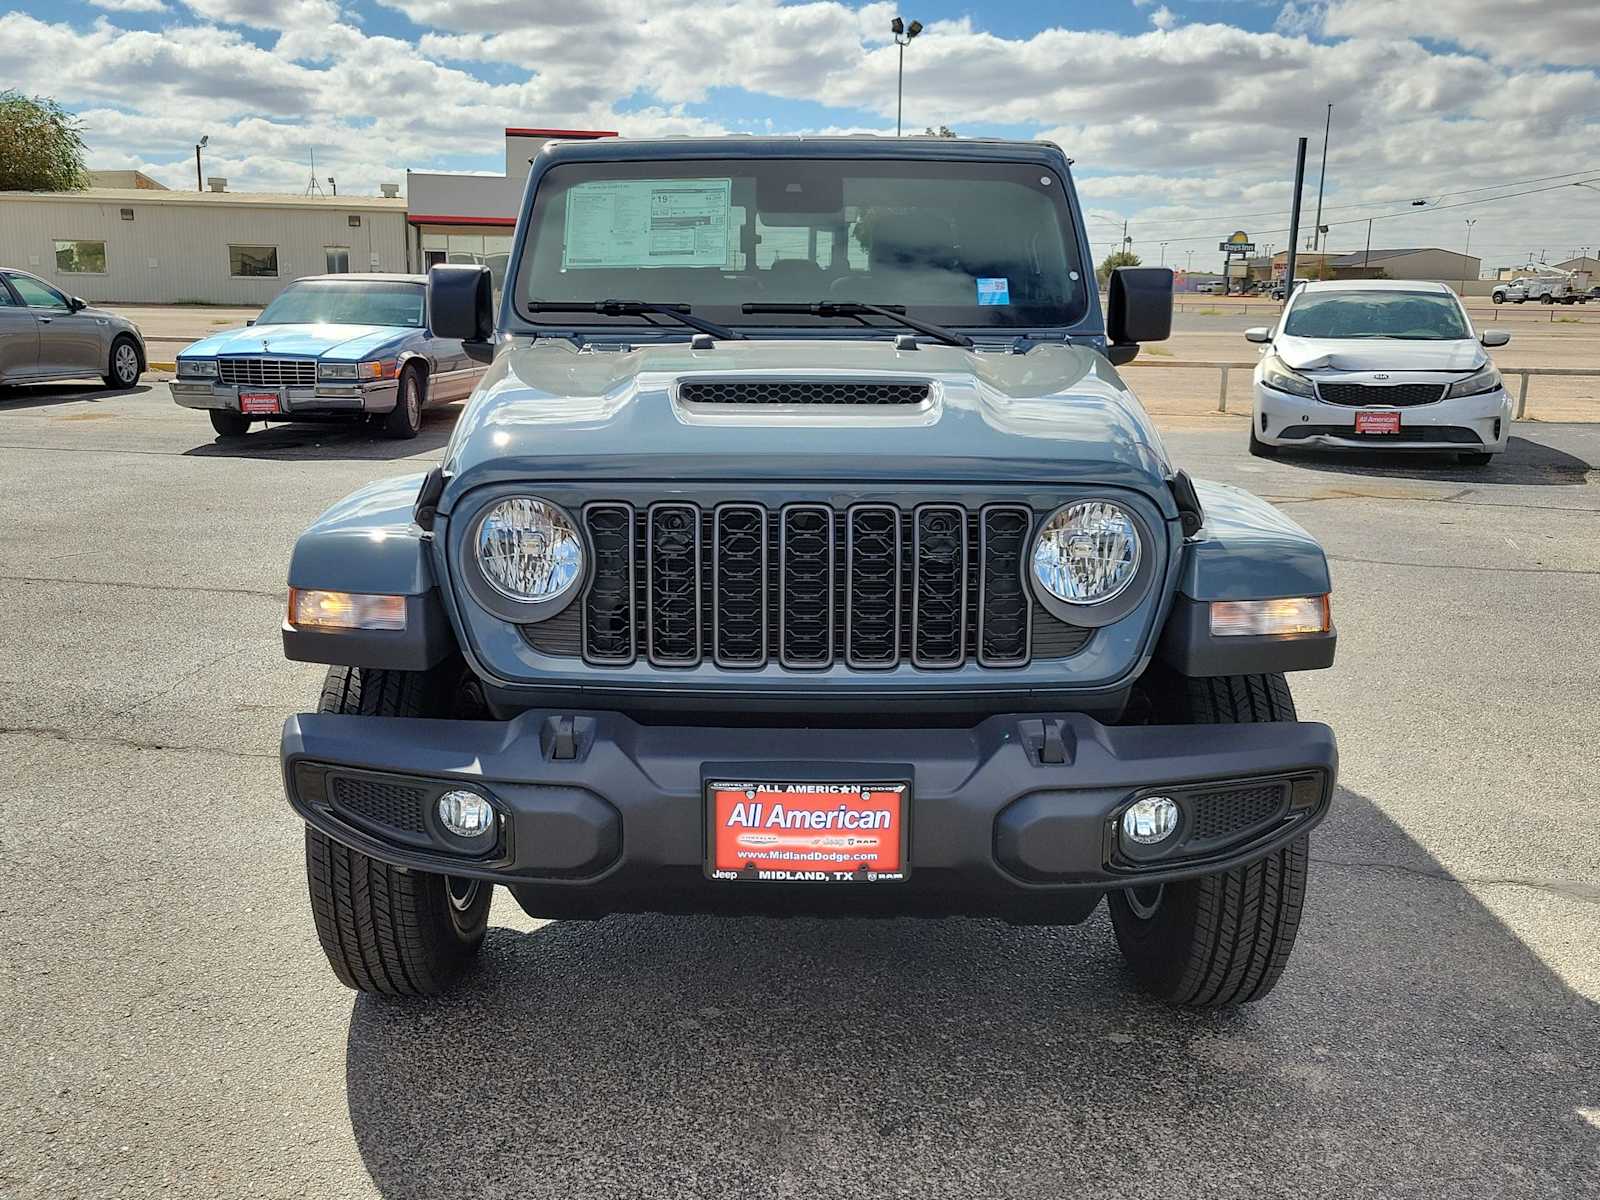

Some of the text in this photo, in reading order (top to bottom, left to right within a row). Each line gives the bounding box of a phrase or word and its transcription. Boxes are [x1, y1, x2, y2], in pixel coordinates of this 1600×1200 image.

[757, 784, 782, 793] ALL
[726, 802, 891, 829] All American
[737, 850, 878, 862] www.MidlandDodge.com
[712, 869, 738, 880] Jeep
[758, 871, 854, 881] MIDLAND, TX
